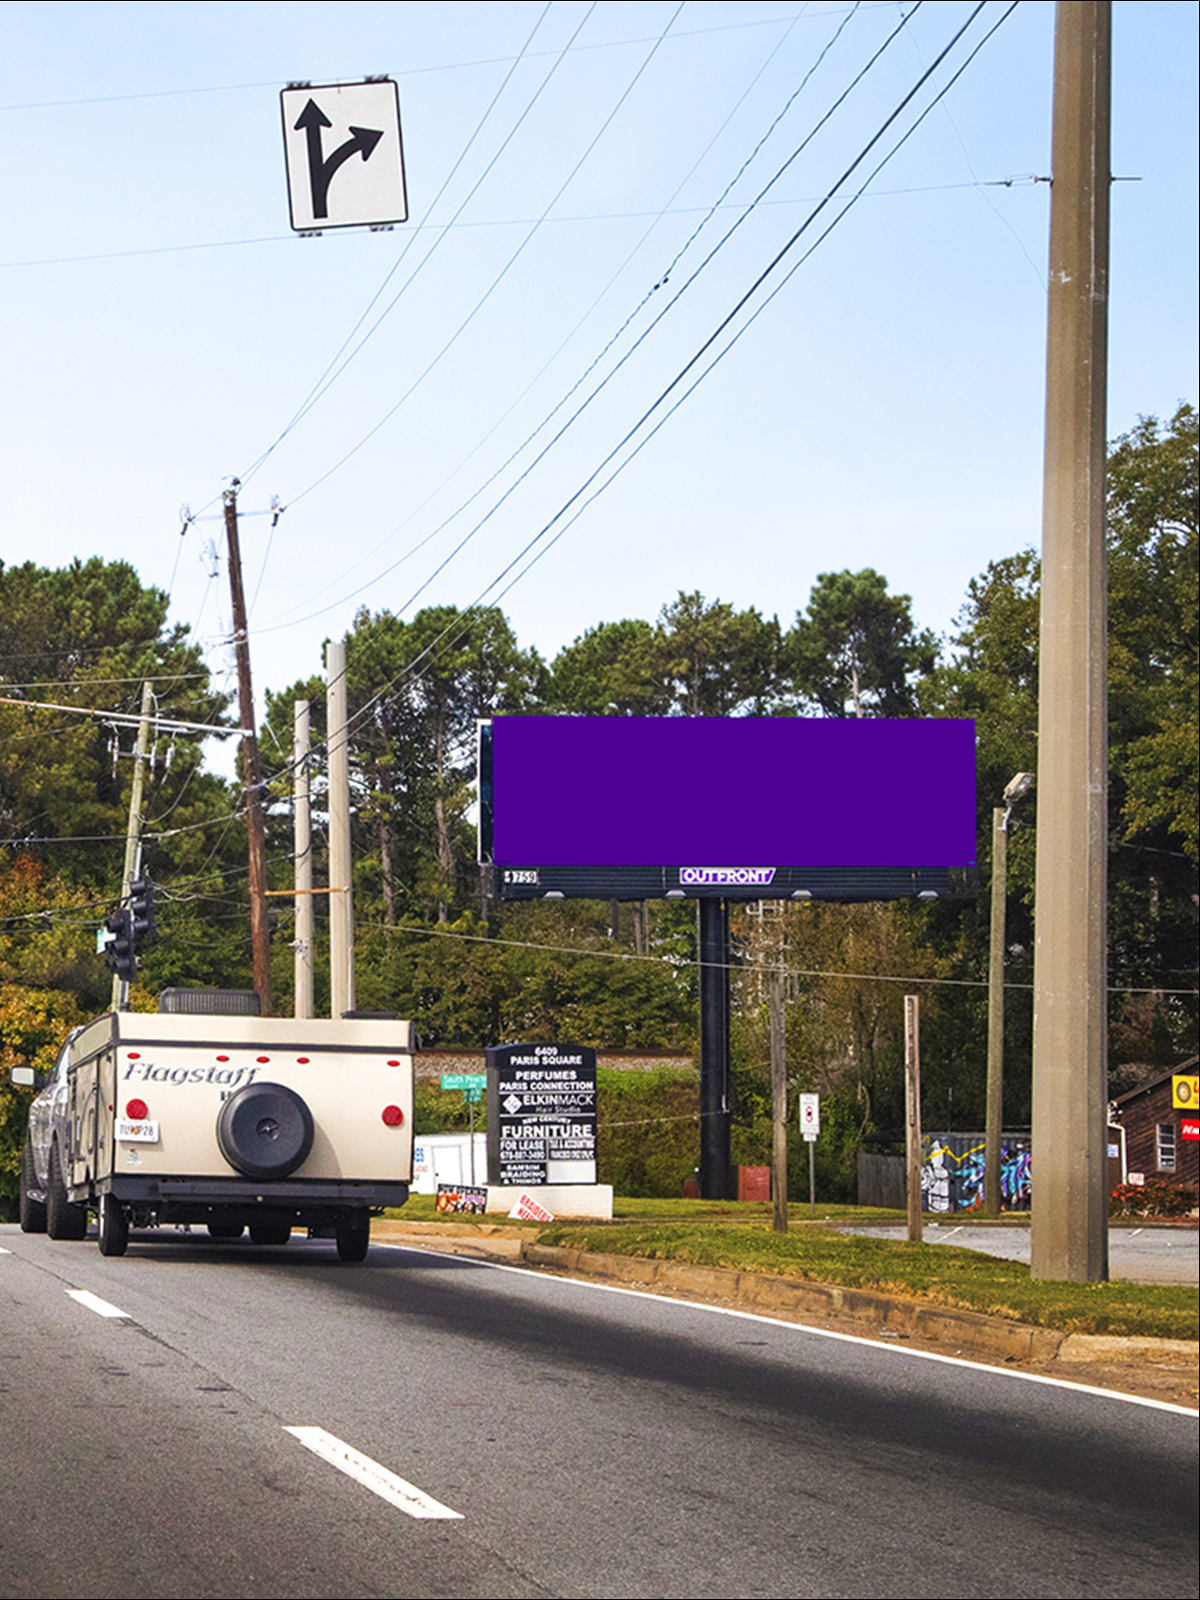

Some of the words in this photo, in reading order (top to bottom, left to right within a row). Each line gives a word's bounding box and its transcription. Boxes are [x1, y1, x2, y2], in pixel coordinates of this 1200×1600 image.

[683, 870, 770, 883] OUTFRONT
[510, 1056, 540, 1065] PARIS
[542, 1055, 582, 1065] SQUARE
[123, 1061, 261, 1088] Flagstaff
[515, 1070, 577, 1080] PERFUMES
[499, 1081, 528, 1090] PARIS
[530, 1081, 594, 1090] CONNECTION
[523, 1093, 594, 1106] ELKINMACK
[502, 1124, 593, 1138] FURNITURE
[500, 1140, 517, 1150] FOR
[519, 1140, 544, 1150] LEASE
[500, 1171, 546, 1179] BRAIDING
